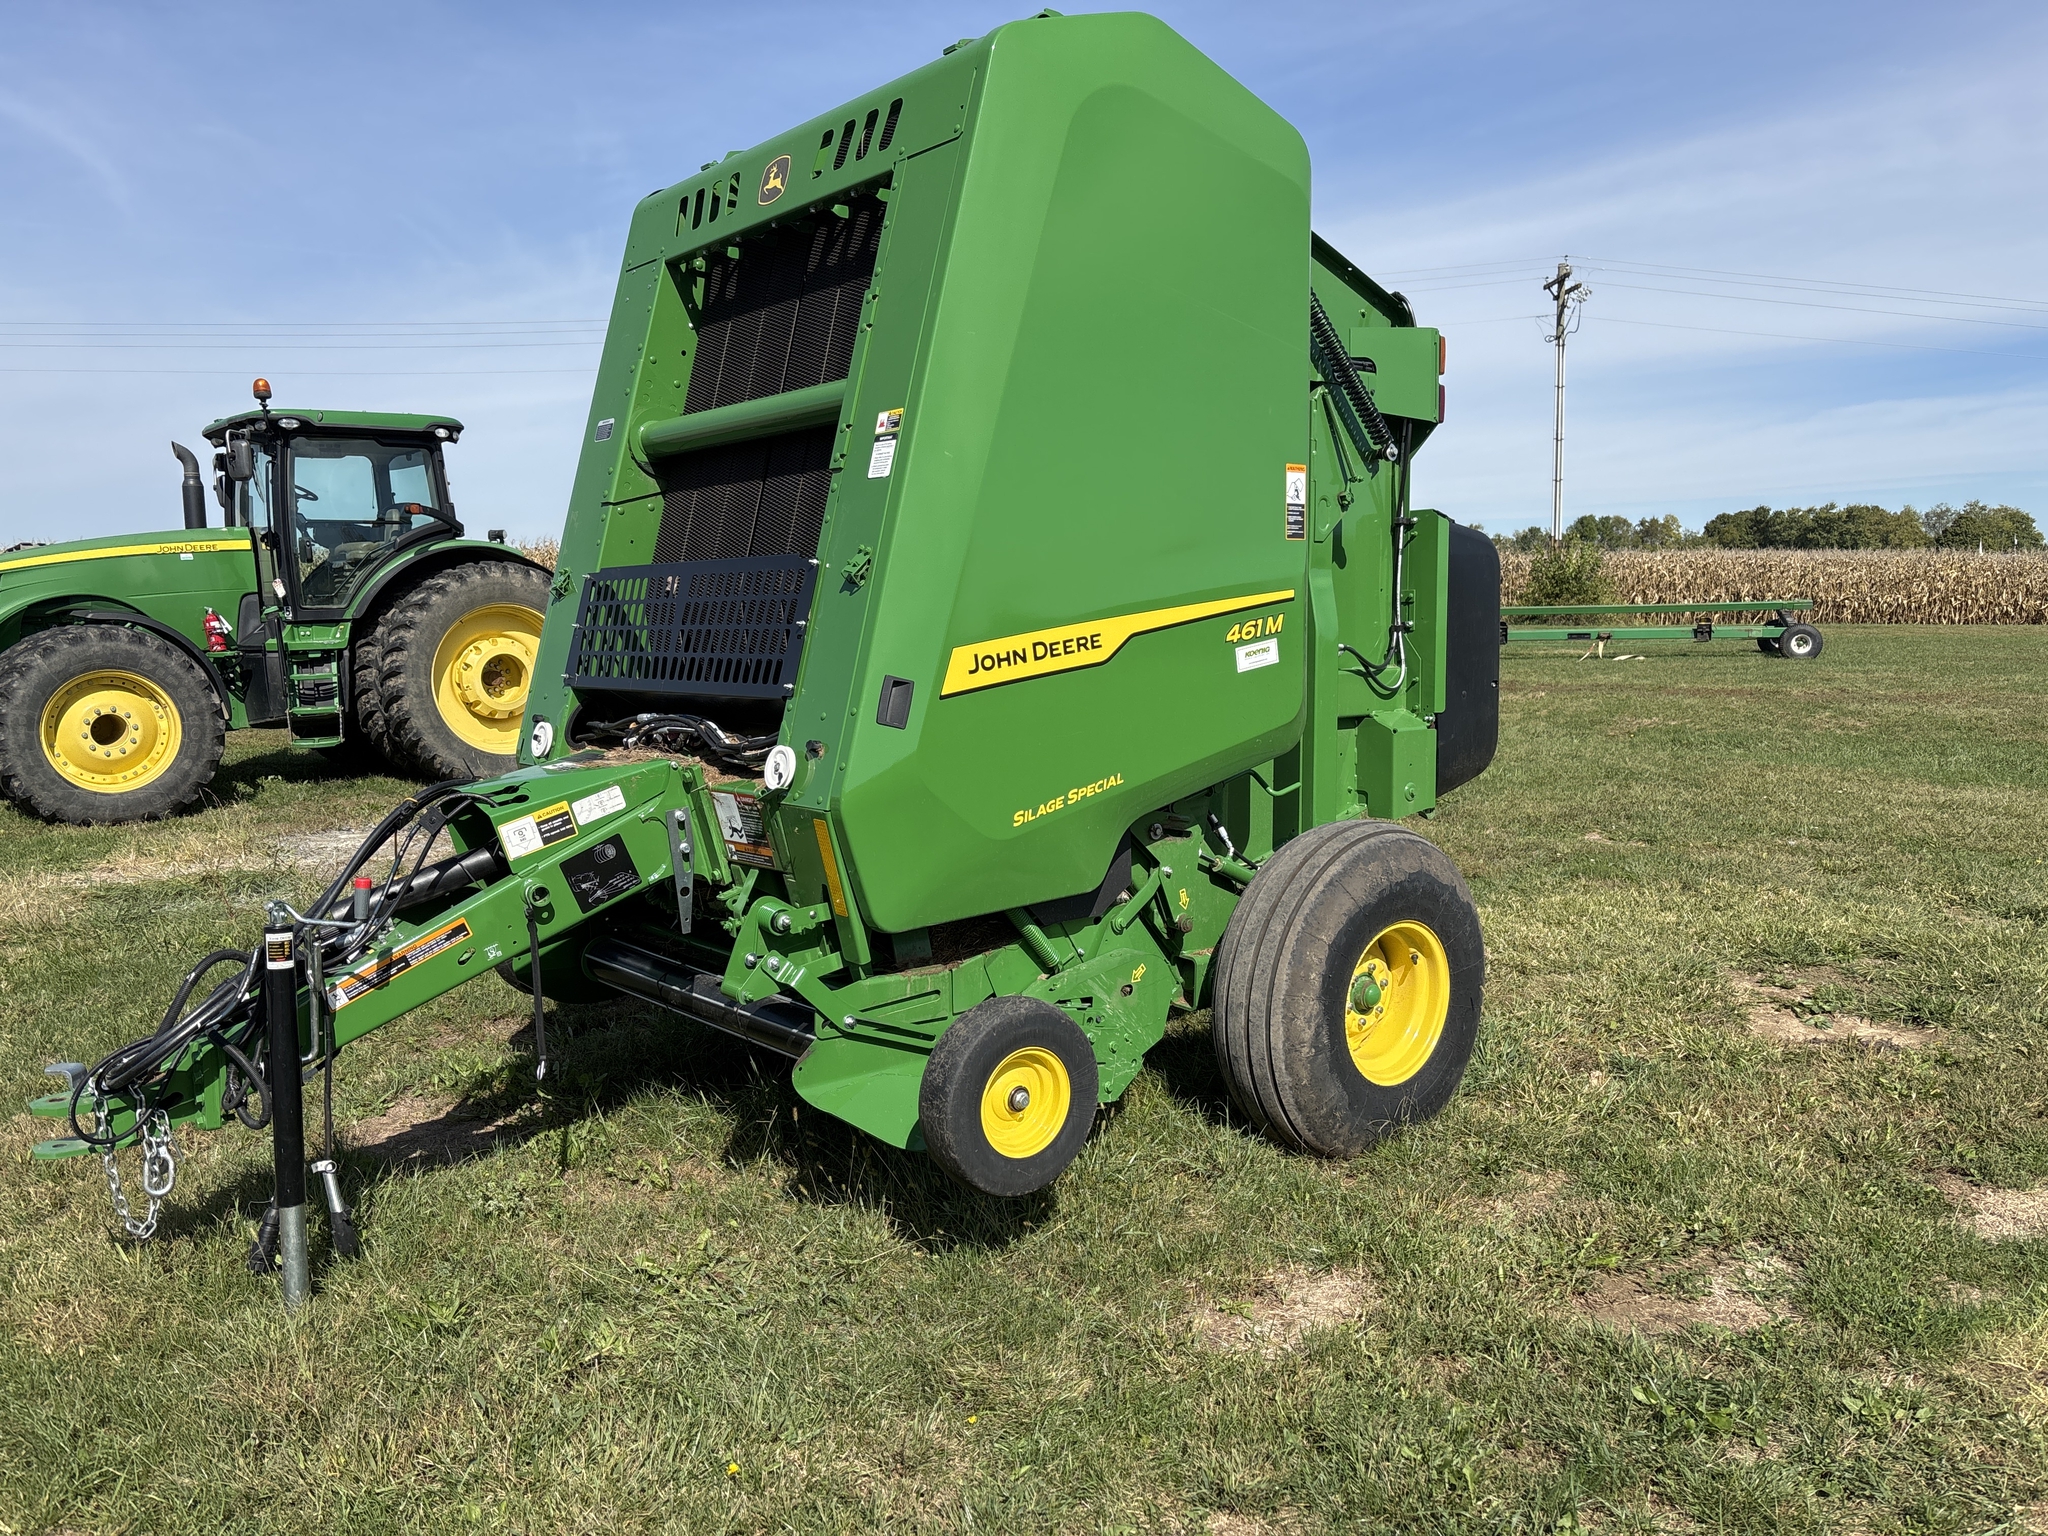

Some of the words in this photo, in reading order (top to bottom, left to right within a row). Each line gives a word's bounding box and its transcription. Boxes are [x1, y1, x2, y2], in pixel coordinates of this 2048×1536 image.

[157, 545, 184, 553] JOHN
[1225, 617, 1264, 644] 461
[1264, 612, 1285, 637] M
[968, 648, 1027, 674] JOHN
[1032, 633, 1102, 661] DEERE
[542, 805, 565, 817] CAUTION
[1013, 795, 1065, 827] SILAGE
[1067, 772, 1124, 804] SPECIAL
[392, 943, 418, 960] WARNING
